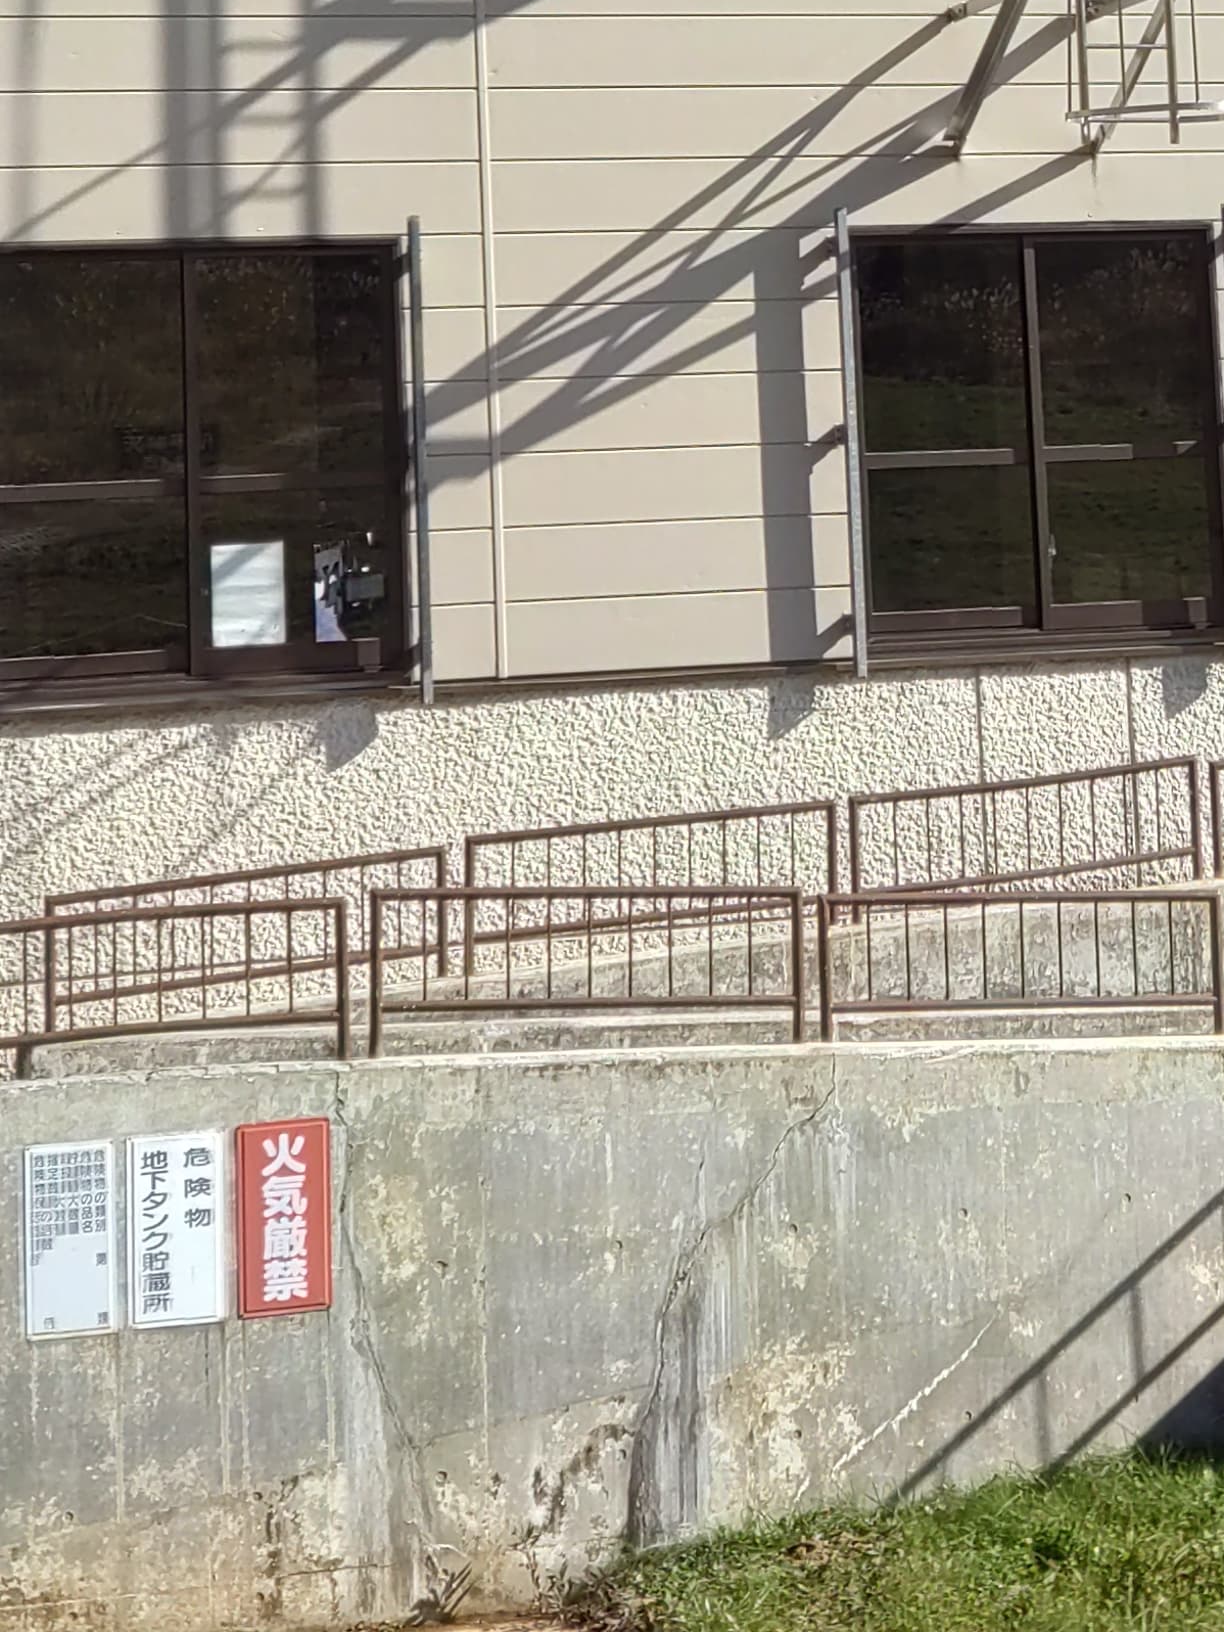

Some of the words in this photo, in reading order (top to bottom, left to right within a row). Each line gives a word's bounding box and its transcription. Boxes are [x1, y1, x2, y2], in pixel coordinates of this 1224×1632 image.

[140, 1149, 172, 1315] 地下タンク貯蔵所
[183, 1146, 212, 1229] 危険物
[261, 1132, 309, 1303] 火気厳禁
